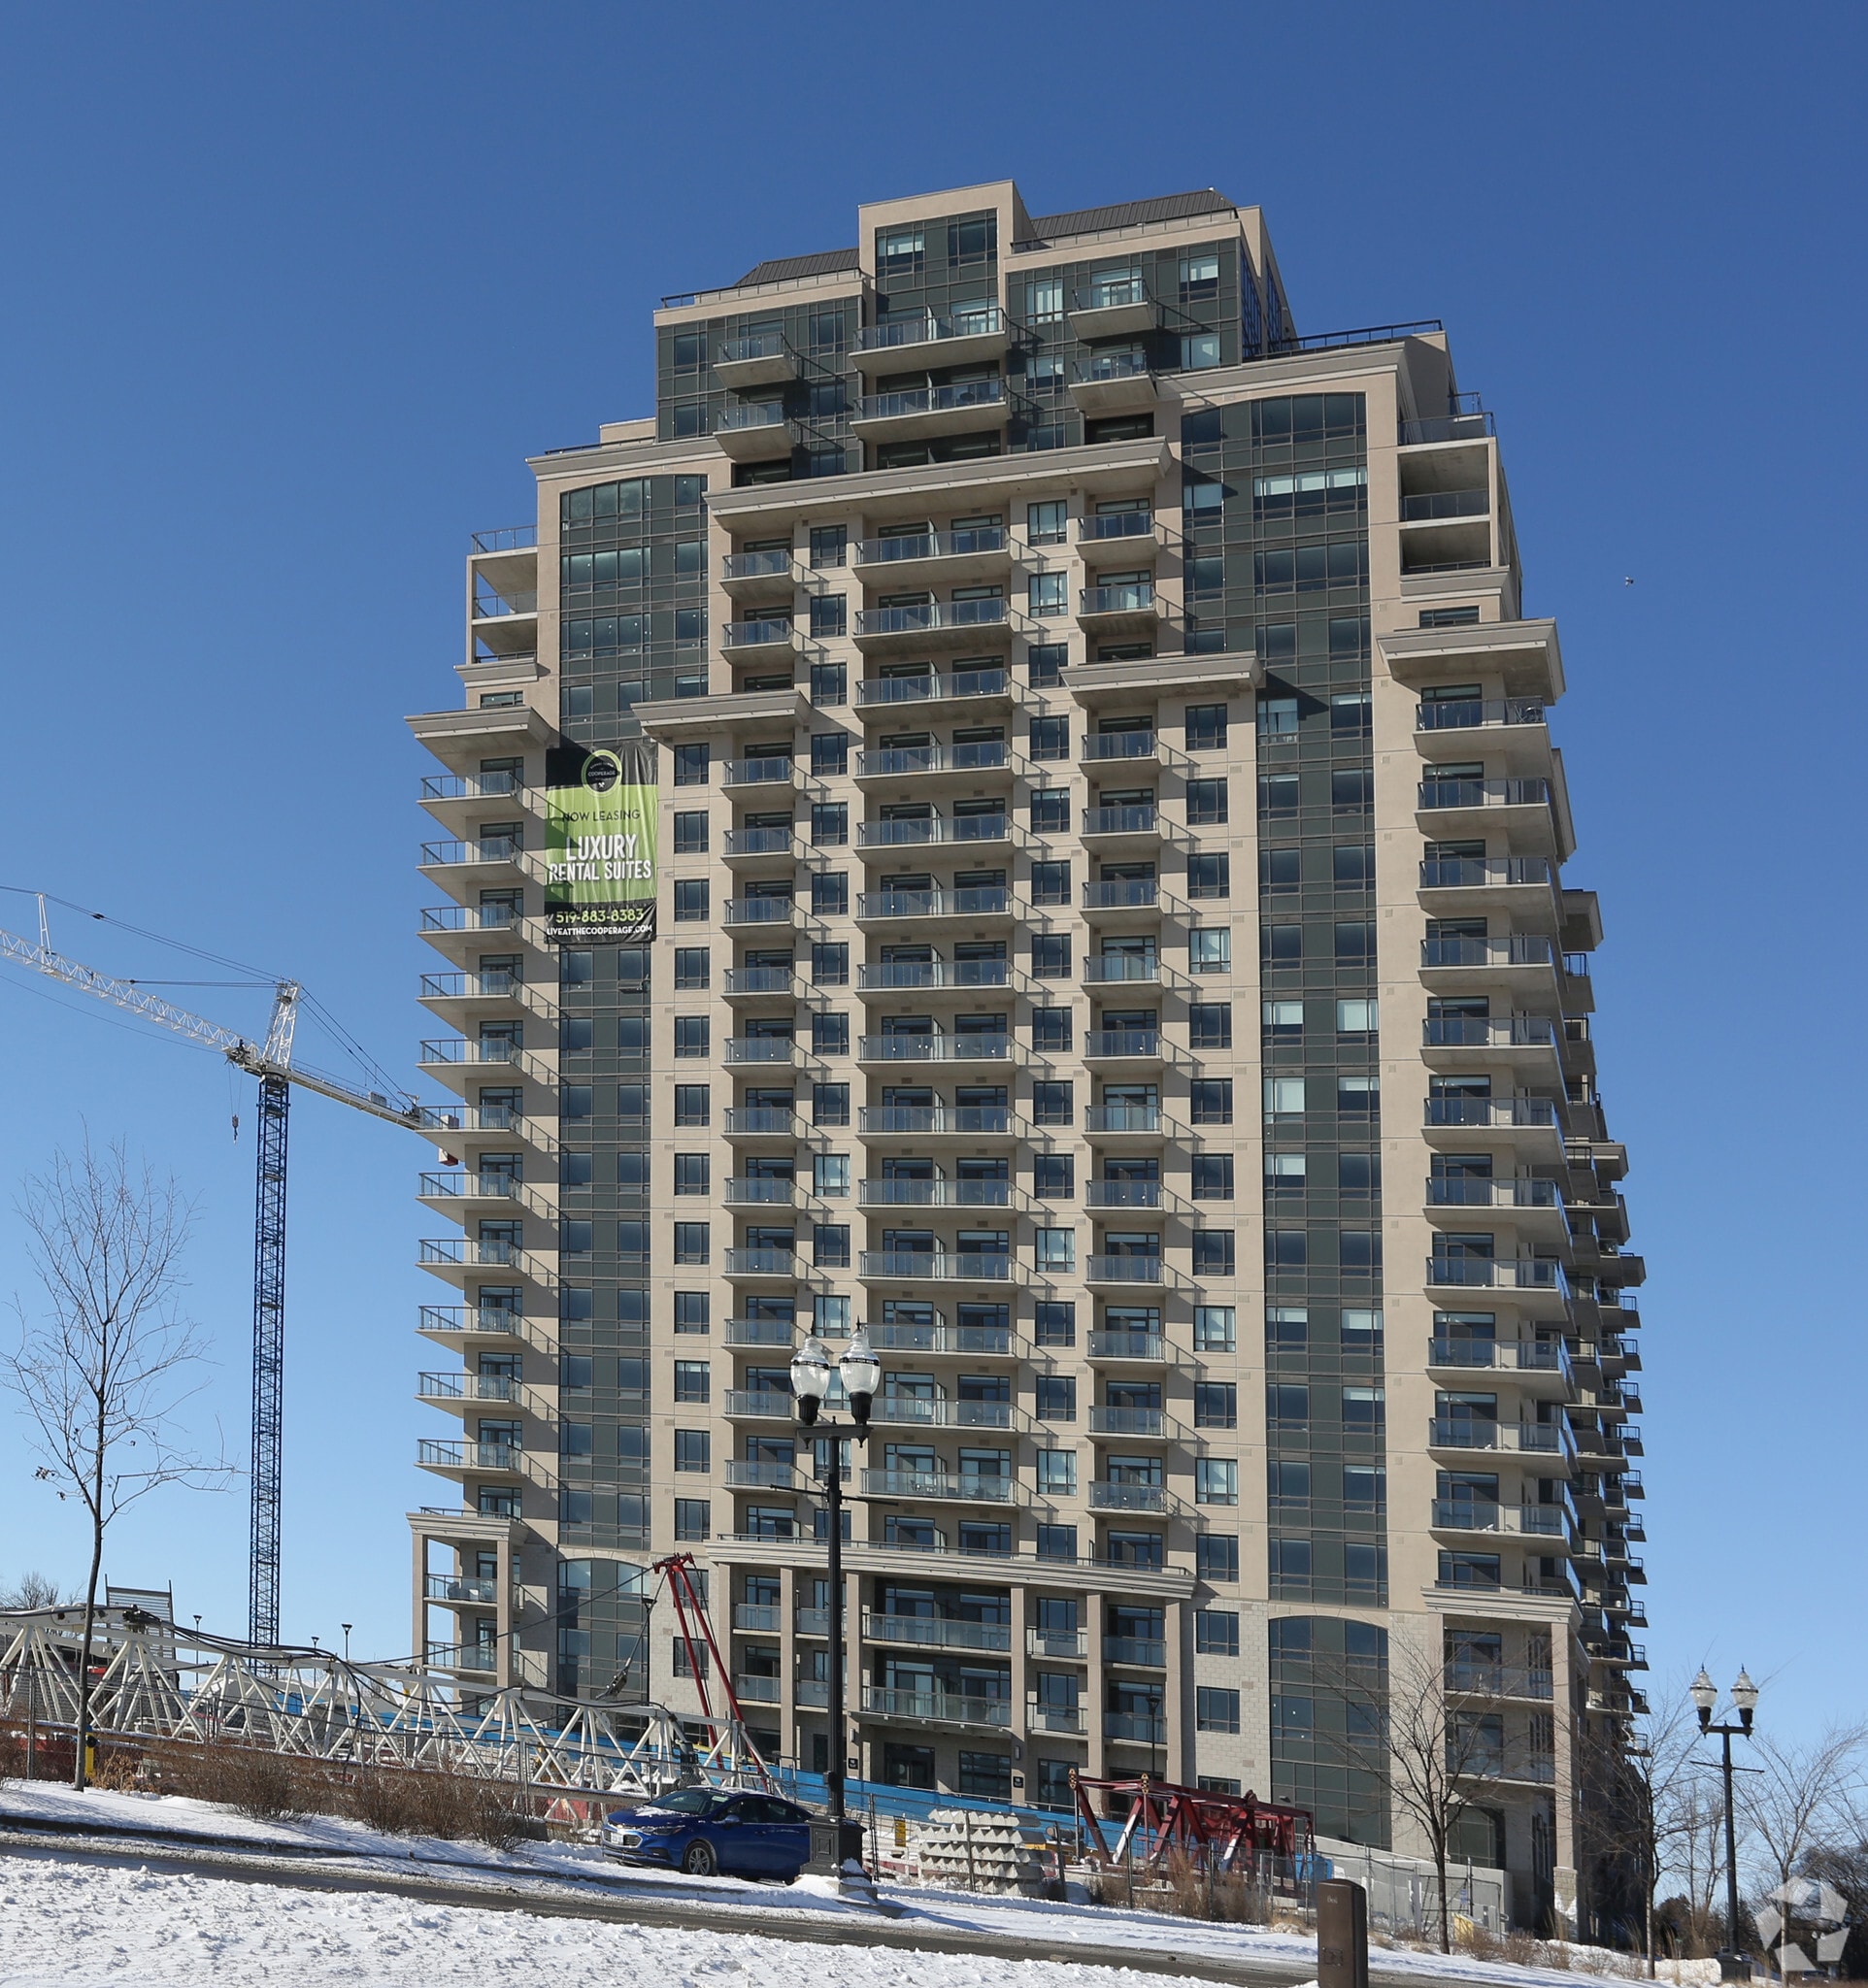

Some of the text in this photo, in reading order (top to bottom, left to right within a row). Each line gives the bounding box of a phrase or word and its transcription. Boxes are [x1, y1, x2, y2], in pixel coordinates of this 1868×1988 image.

[562, 809, 641, 822] NOW LEASING
[565, 833, 637, 862] LUXURY
[549, 859, 652, 881] RENTAL SUITES
[555, 908, 645, 924] 519-883-8383
[546, 924, 653, 937] LIVEATTHECOOPERAGE.COM
